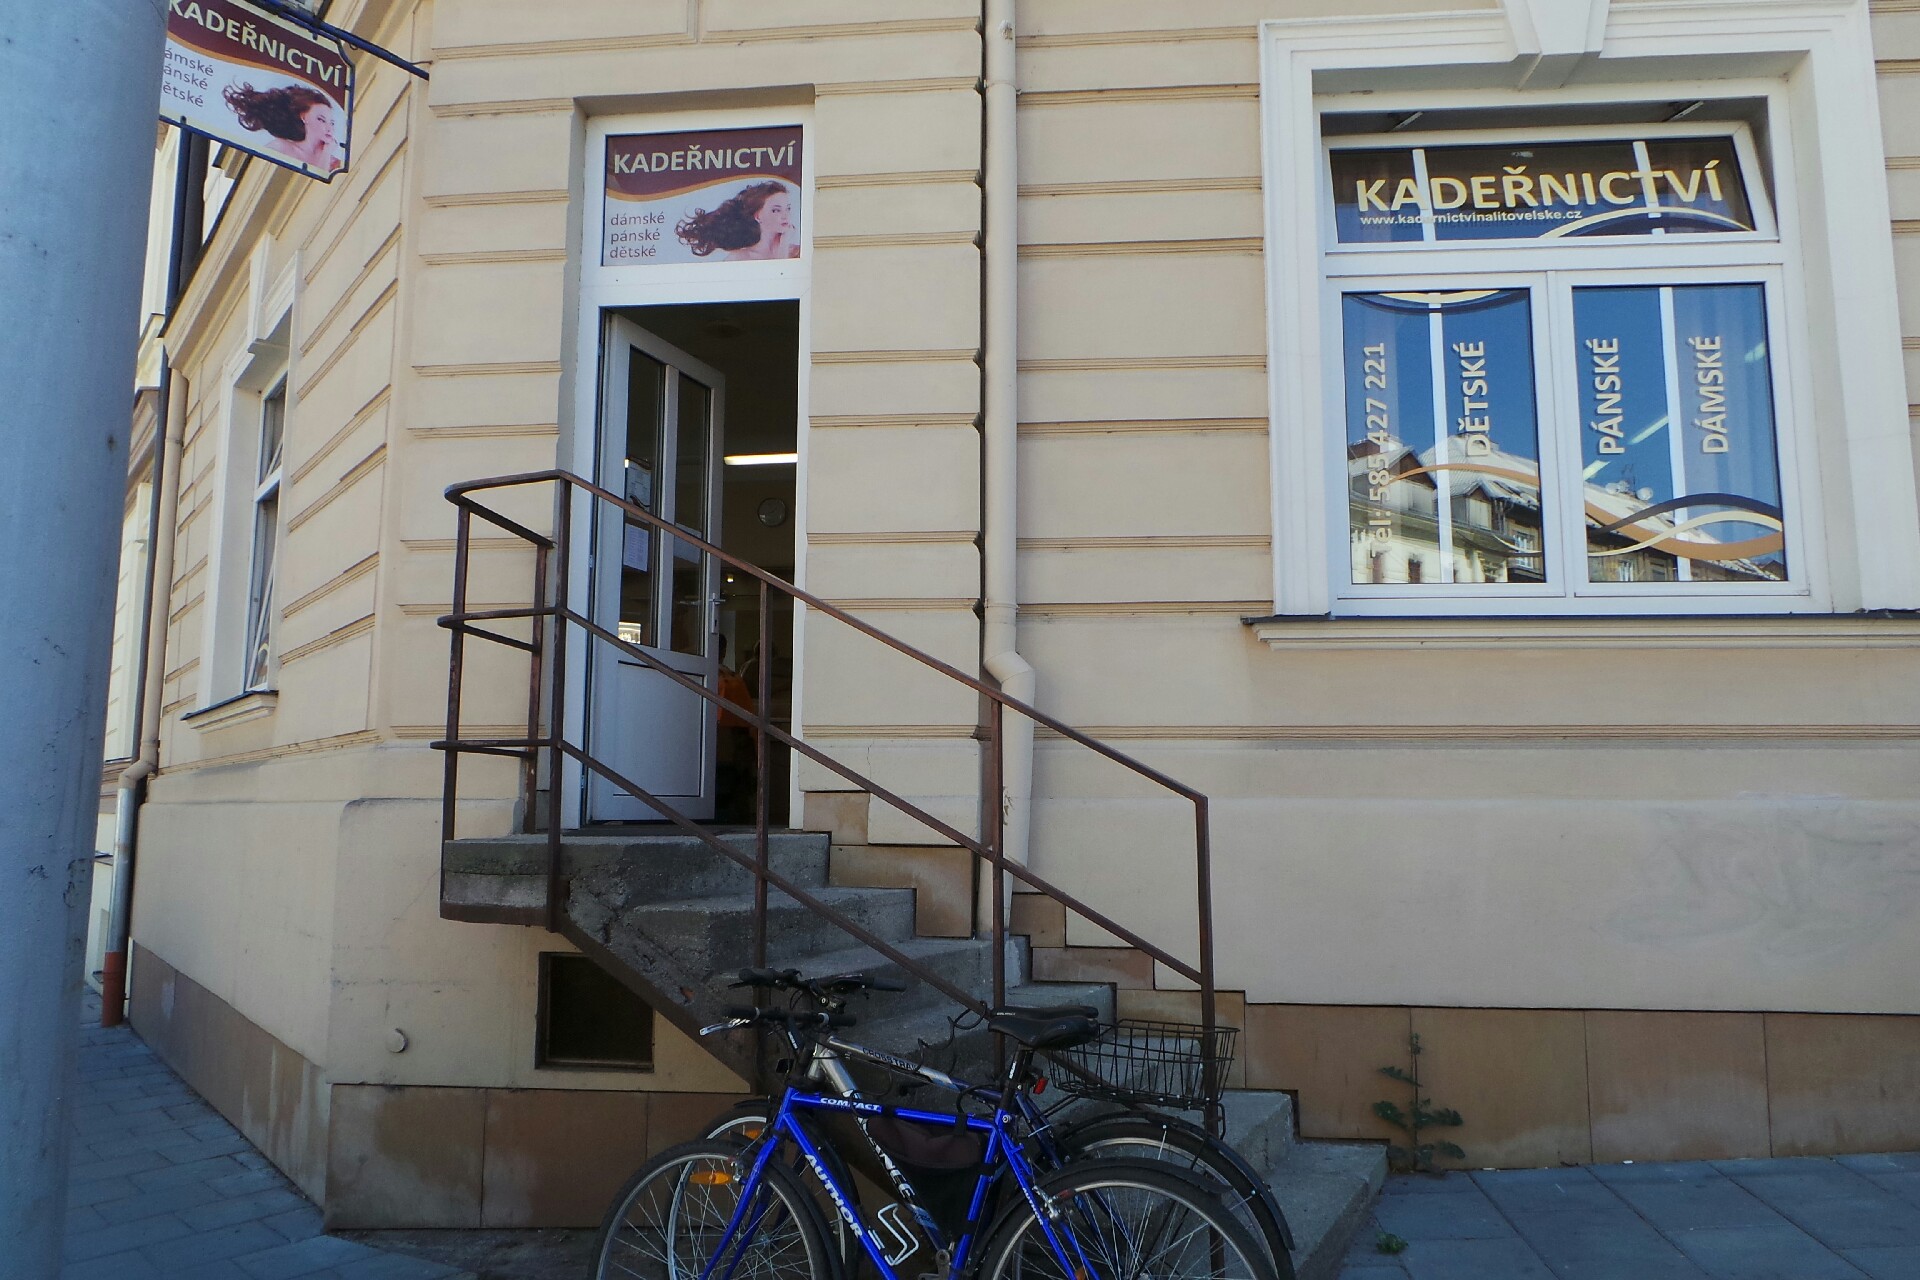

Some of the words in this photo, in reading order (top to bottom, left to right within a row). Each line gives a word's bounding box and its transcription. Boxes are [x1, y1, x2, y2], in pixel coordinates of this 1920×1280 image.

[163, 63, 208, 90] ánské
[164, 47, 214, 77] ámské
[162, 81, 204, 108] ětské
[613, 140, 796, 174] KADEŘNICTVÍ
[1355, 159, 1723, 212] KADEŘNICTVÍ
[610, 211, 665, 226] dámské
[610, 227, 661, 245] pánské
[1359, 208, 1584, 226] www.kadrnictvinalitovelske.cz
[609, 244, 657, 259] dětské
[1363, 342, 1387, 390] 221
[1452, 340, 1491, 457] DĚTSKÉ
[1584, 337, 1626, 455] PÁNSKÉ
[1687, 335, 1730, 454] DÁMSKÉ
[1365, 397, 1389, 448] 427
[1367, 453, 1390, 502] 585
[804, 1153, 864, 1239] AUTHOR
